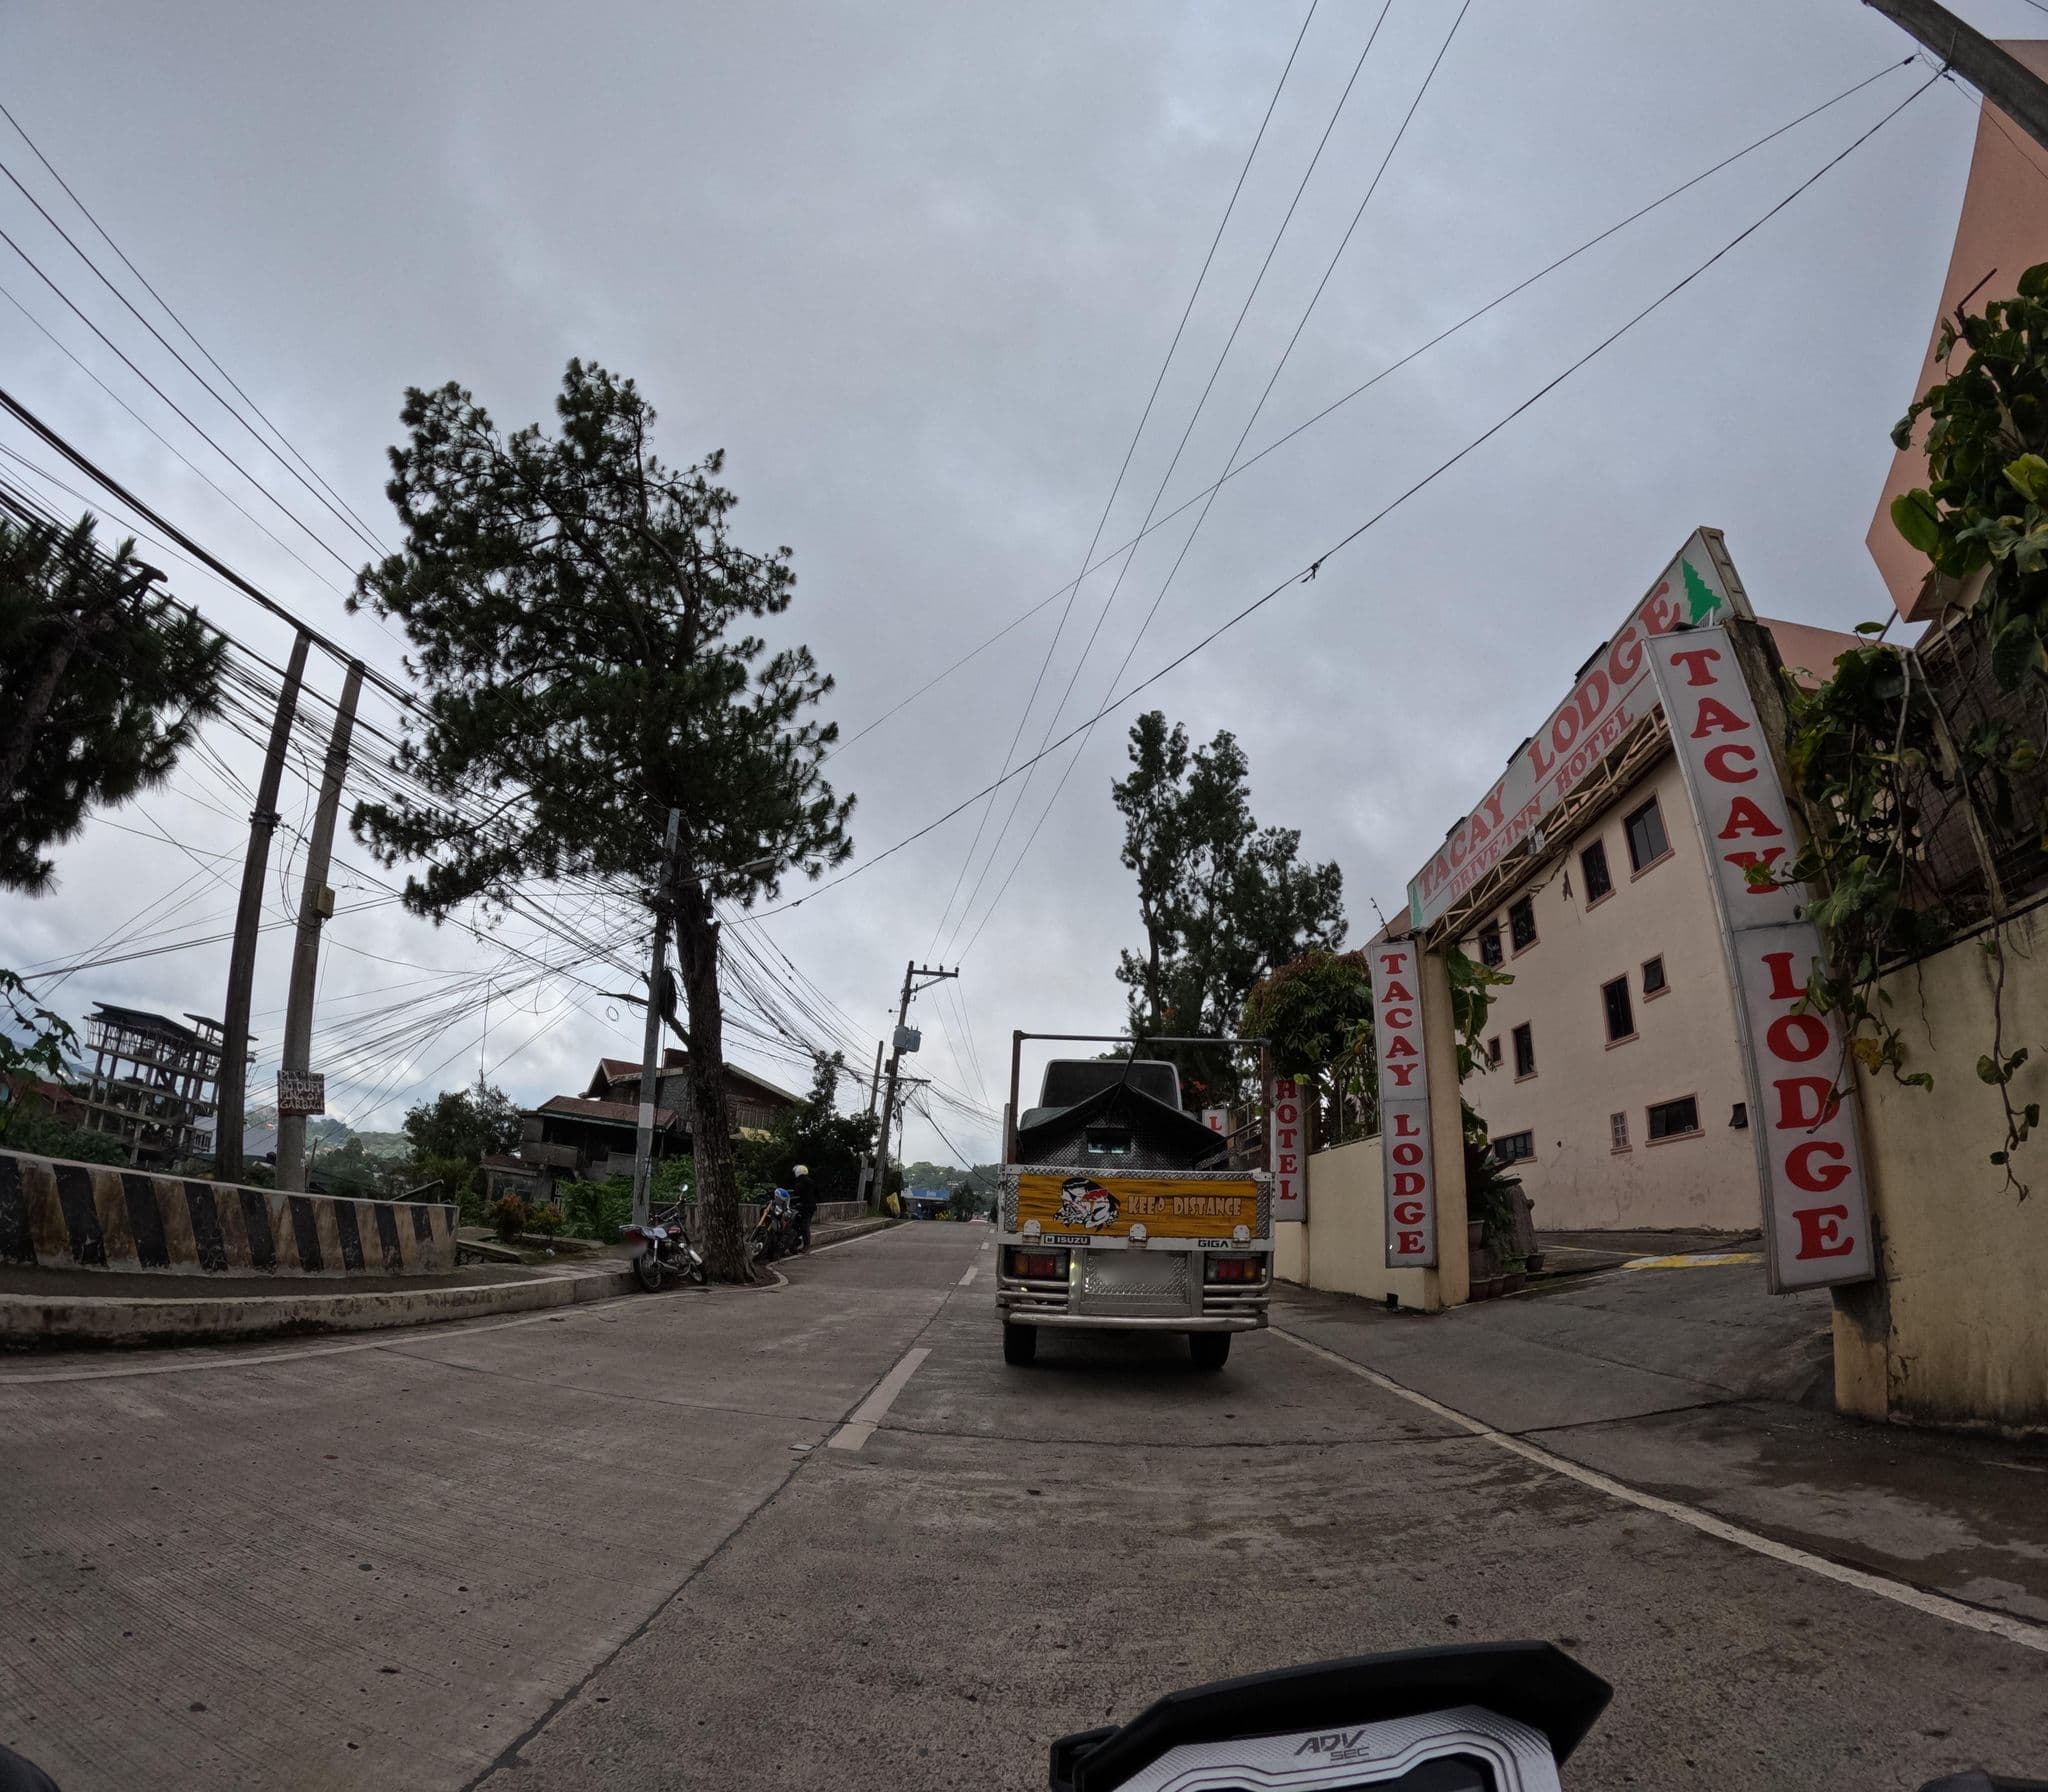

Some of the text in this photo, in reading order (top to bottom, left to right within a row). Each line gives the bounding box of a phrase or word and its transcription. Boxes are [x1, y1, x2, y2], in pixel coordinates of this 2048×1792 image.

[1418, 582, 1680, 900] TACAY LODGE
[1555, 705, 1634, 796] HOTEL
[1670, 648, 1854, 1260] TACAY LODGE
[1380, 953, 1425, 1254] TACAY LODGE
[1275, 1079, 1298, 1200] HOTEL
[1128, 1195, 1241, 1216] KEEP DISTANCE
[1057, 1236, 1088, 1244] ISUZU
[1198, 1240, 1229, 1248] GIGA
[1294, 1729, 1366, 1755] ADV
[1330, 1746, 1369, 1761] SEC
